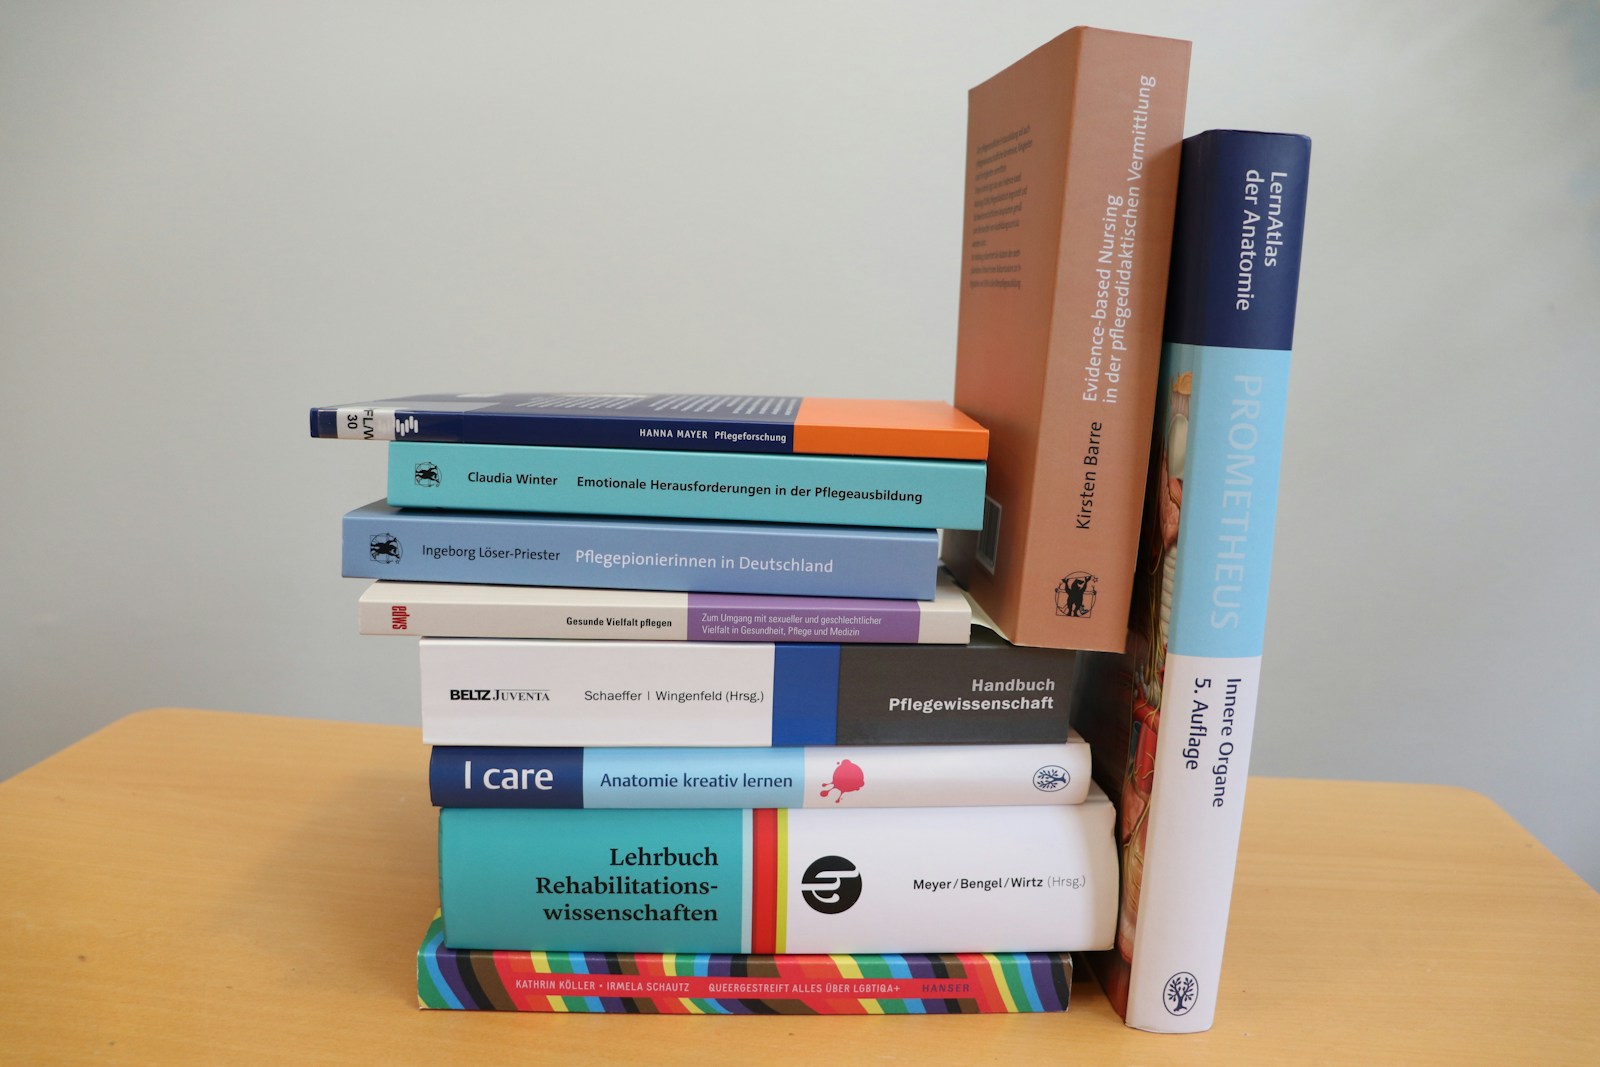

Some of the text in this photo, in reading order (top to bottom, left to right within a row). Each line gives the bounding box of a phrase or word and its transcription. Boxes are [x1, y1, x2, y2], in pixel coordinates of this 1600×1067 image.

[1265, 171, 1288, 268] LernAtlas
[1103, 75, 1156, 404] in der pflegedidaktischen Vermittlung
[1236, 169, 1265, 311] der Anatomie
[1082, 194, 1123, 402] Evidence-based Nursing
[347, 414, 358, 429] 30
[639, 428, 787, 444] HANNA MAYER Pflegeforschung
[467, 471, 558, 486] Claudia Winter
[1075, 421, 1103, 529] Kirsten Barre
[577, 476, 923, 505] Emotionale Herausforderungen in der Pflegeausbildung
[1210, 374, 1264, 630] PROMETHEUS
[422, 545, 560, 562] Ingeborg Löser-Priester
[575, 549, 834, 574] Pflegepionierinnen in Deutschland
[566, 616, 672, 629] Gesunde Vielfalt pflegen
[702, 613, 882, 626] Zum Umgang mit sexueller und geschlechtlicher
[702, 625, 860, 637] Vielfalt in Gesundheit, Pflege und Medizin
[971, 678, 1055, 692] Handbuch
[450, 689, 550, 701] BELTZ JUVENTA
[584, 690, 642, 701] Schaeffer
[655, 690, 722, 703] Wingenfeld
[725, 690, 765, 703] (Hrsg.)
[888, 697, 1054, 713] Pflegewissenschaft
[1182, 677, 1211, 771] 5. Auflage
[1212, 677, 1242, 808] Innere Organe
[464, 760, 554, 791] I care
[600, 772, 793, 789] Anatomie kreativ lernen
[609, 847, 719, 866] Lehrbuch
[535, 876, 719, 895] Rehabilitations-
[1047, 875, 1086, 889] (Hrsg.)
[543, 904, 719, 922] wissenschaften
[516, 979, 690, 992] KATHRIN KÖLLER IRMELA SCHAUTZ
[708, 983, 901, 993] QUEERGESTREIFT ALLES ÜBER LGBTIQA+
[921, 984, 970, 993] HANSER
